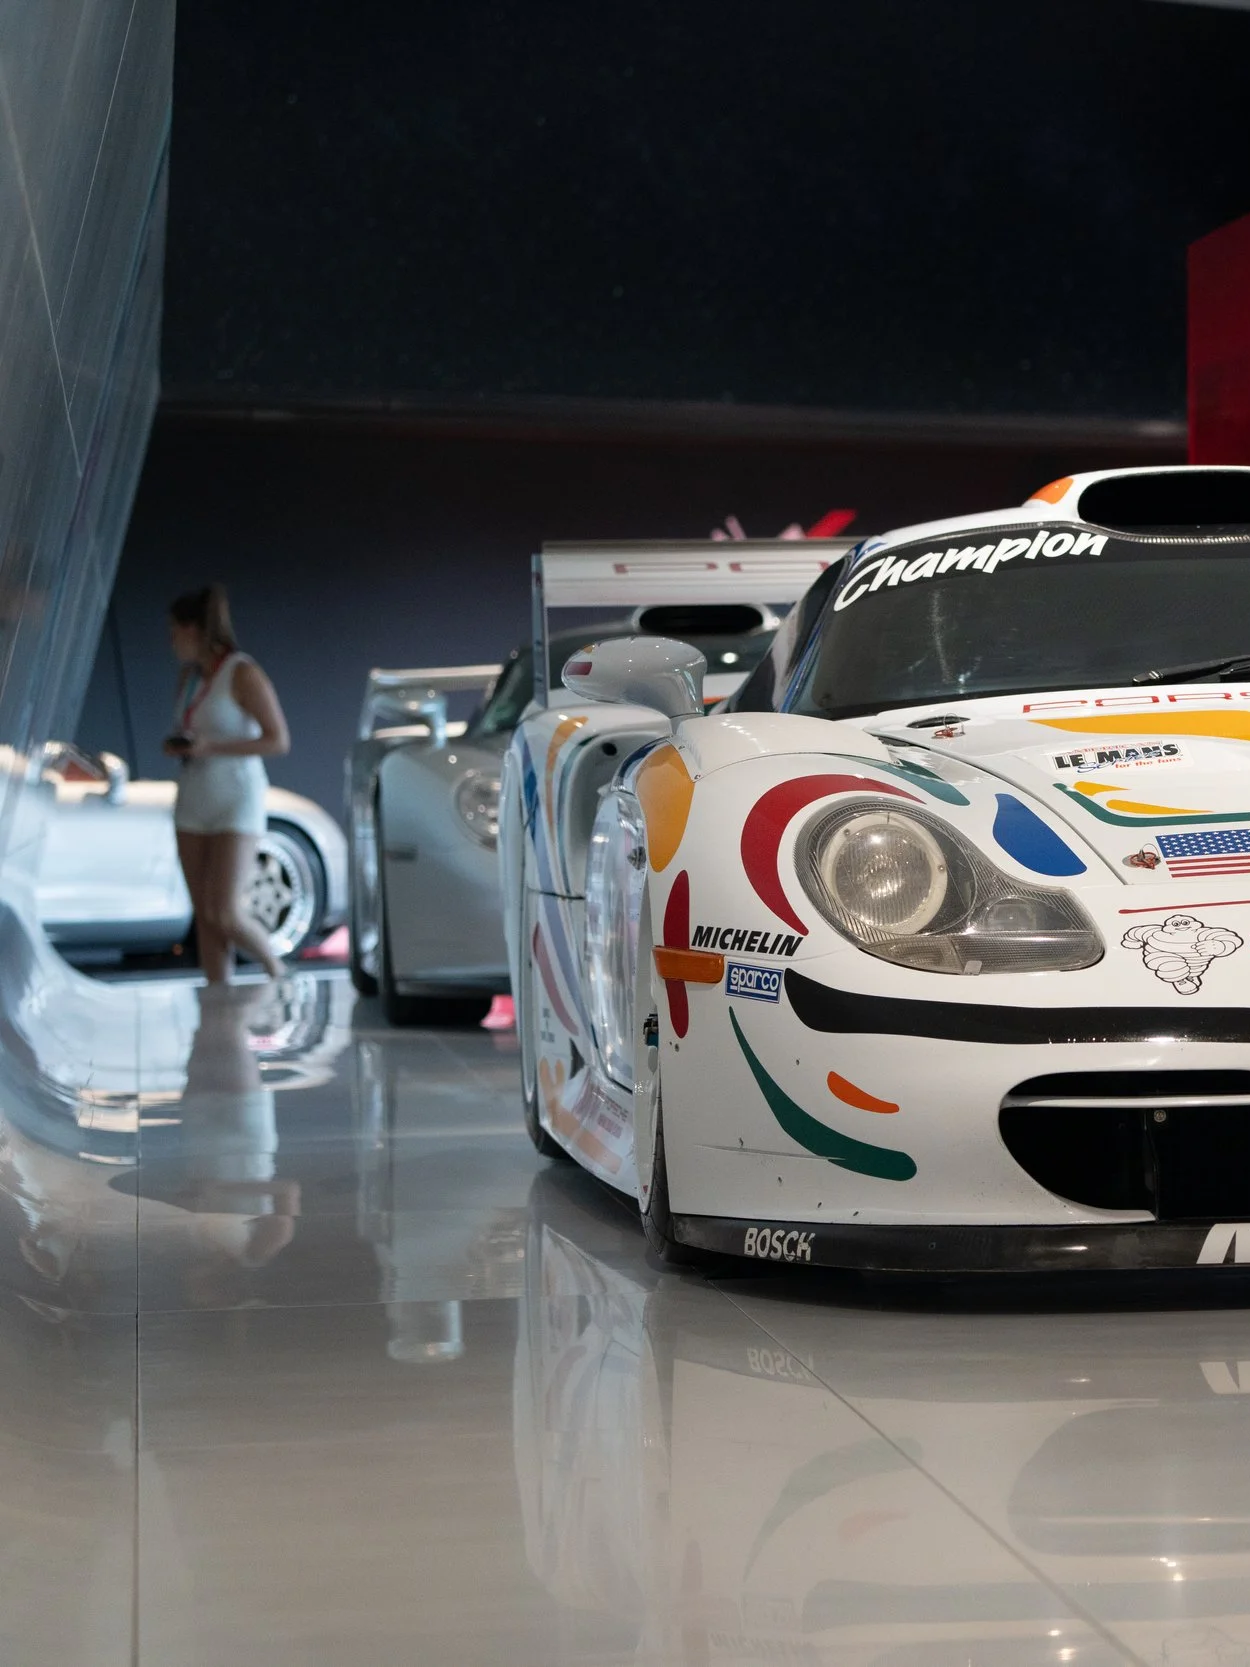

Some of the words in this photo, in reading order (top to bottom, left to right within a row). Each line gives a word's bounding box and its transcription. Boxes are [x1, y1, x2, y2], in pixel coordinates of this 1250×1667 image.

[834, 530, 1108, 612] Champion
[1053, 753, 1086, 769] LE
[1096, 743, 1180, 764] MANS
[691, 925, 804, 957] MICHELIN
[730, 967, 780, 993] sparco
[743, 1227, 816, 1262] BOSCH
